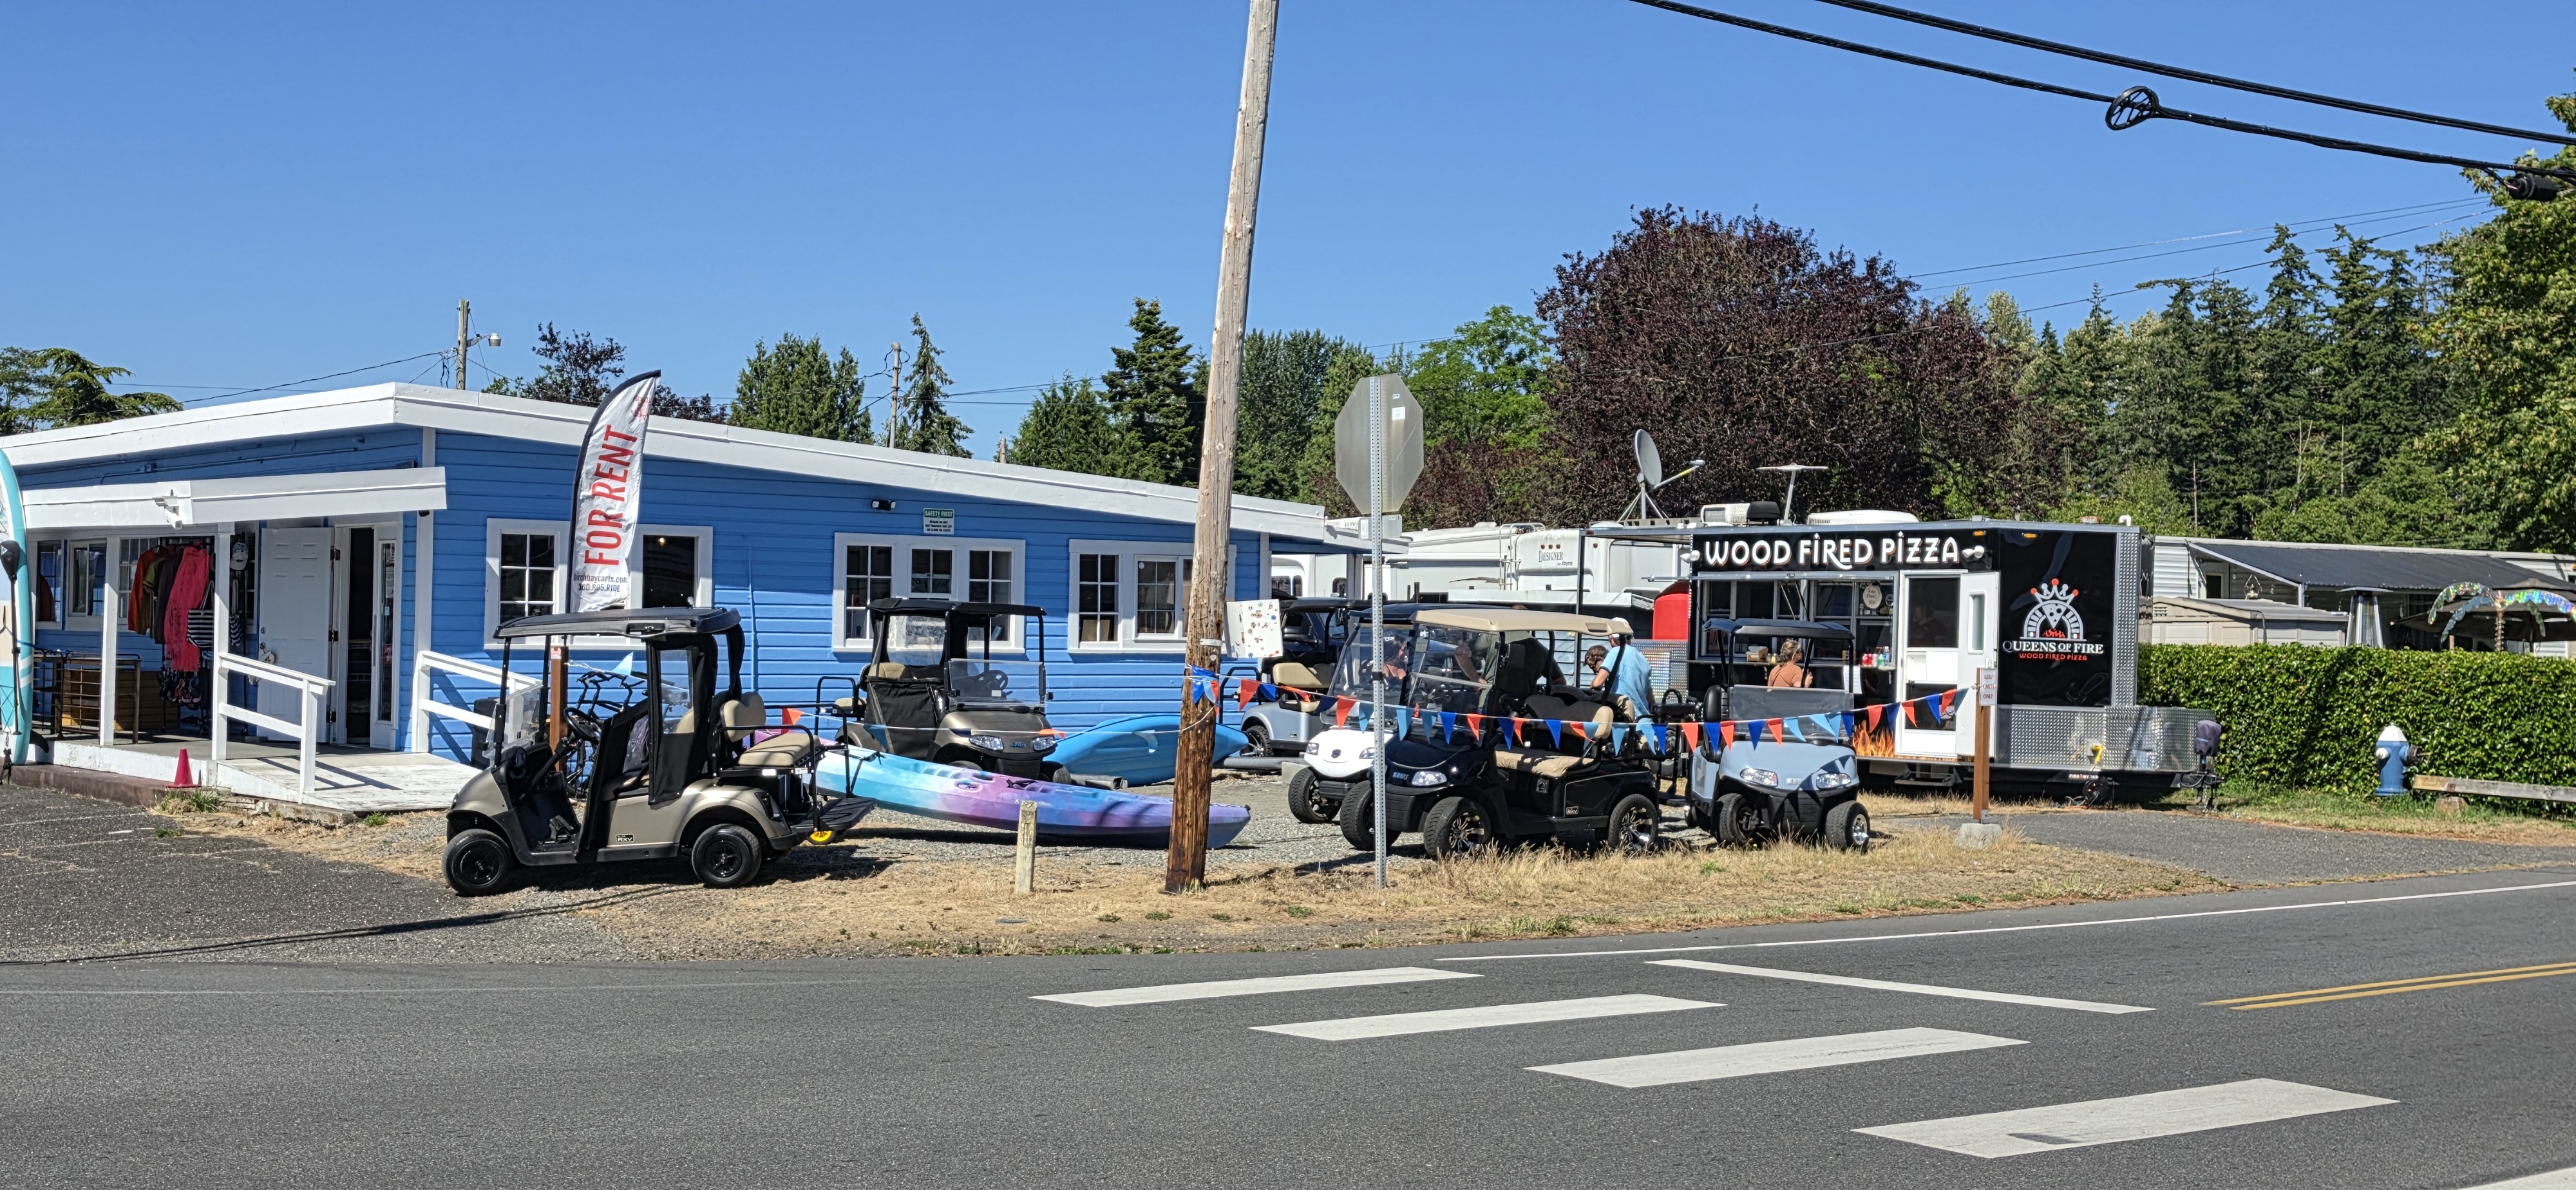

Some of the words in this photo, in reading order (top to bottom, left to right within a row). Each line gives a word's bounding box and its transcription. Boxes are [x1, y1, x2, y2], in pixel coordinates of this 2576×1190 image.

[591, 424, 638, 502] RENT
[584, 509, 623, 566] FOR
[1539, 551, 1564, 563] DESIGNER
[1705, 540, 1792, 565] WOOD
[578, 583, 621, 592] 360.805.RIDE
[2002, 640, 2056, 653] QUEENS
[2058, 643, 2072, 652] OF
[2073, 643, 2104, 654] FIRE
